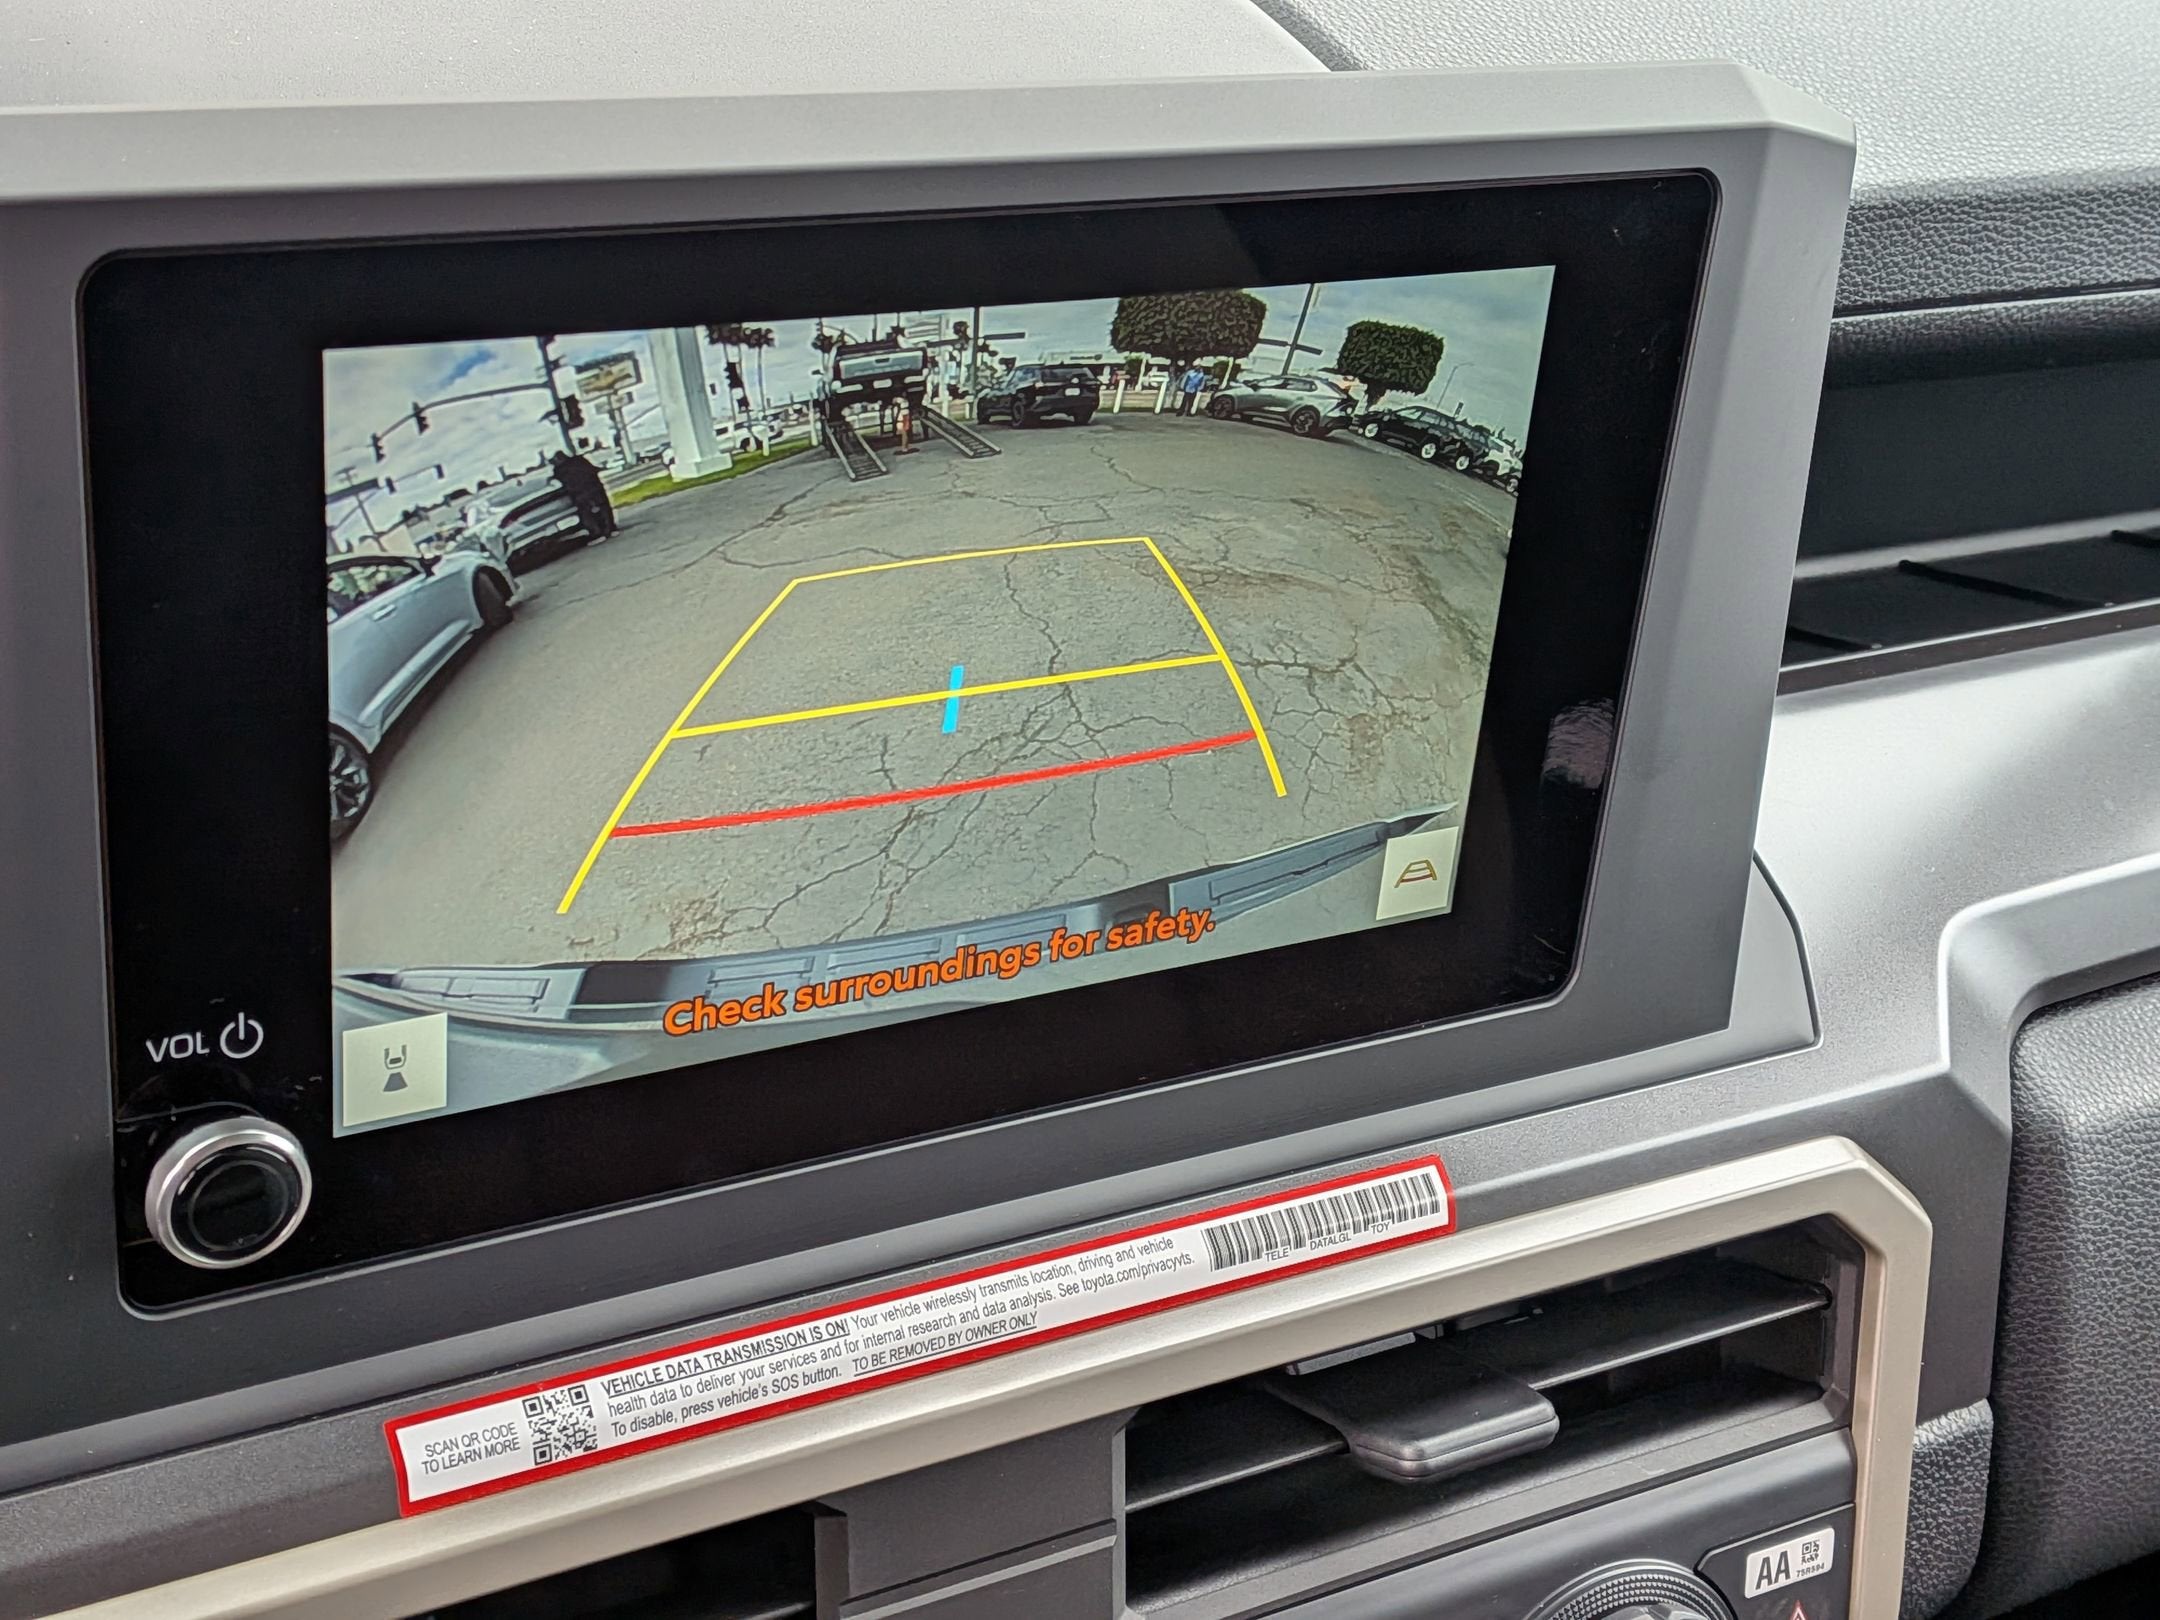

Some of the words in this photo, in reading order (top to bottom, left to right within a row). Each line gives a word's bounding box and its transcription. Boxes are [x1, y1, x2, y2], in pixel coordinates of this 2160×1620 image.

[663, 982, 785, 1037] Check
[793, 935, 1042, 1012] surroundings
[1049, 926, 1100, 963] for
[1105, 905, 1217, 952] safety.
[145, 1031, 210, 1063] VOL
[1265, 1247, 1289, 1262] TELE
[1309, 1234, 1352, 1251] DATALGL
[1371, 1221, 1390, 1235] TOY
[600, 1367, 664, 1396] VEHICLE
[668, 1358, 704, 1380] DATA
[703, 1329, 807, 1365] TRANSMISSION
[811, 1325, 823, 1343] IS
[825, 1318, 850, 1339] ON!
[851, 1315, 878, 1330] Your
[880, 1303, 922, 1323] vehicle
[923, 1286, 977, 1312] wirelessly
[979, 1274, 1029, 1297] transmits
[1030, 1264, 1077, 1284] location,
[1078, 1254, 1114, 1273] driving
[1116, 1247, 1136, 1262] and
[1137, 1237, 1174, 1257] vehicle
[608, 1395, 648, 1418] health
[650, 1389, 678, 1406] data
[680, 1383, 693, 1397] to
[696, 1374, 736, 1394] deliver
[740, 1366, 766, 1388] your
[769, 1352, 817, 1374] services
[820, 1346, 843, 1362] and
[845, 1339, 860, 1354] for
[863, 1325, 905, 1348] internal
[907, 1315, 956, 1338] research
[959, 1306, 981, 1324] and
[982, 1300, 1007, 1318] data
[1008, 1289, 1056, 1312] analysis.
[1057, 1283, 1080, 1298] See
[1083, 1252, 1195, 1294] toyota.com/privacyvts.
[611, 1421, 627, 1438] To
[629, 1410, 678, 1433] disable,
[680, 1402, 715, 1424] press
[717, 1384, 770, 1407] vehicle's
[771, 1377, 800, 1394] SOS
[802, 1365, 843, 1387] button.
[852, 1357, 869, 1373] TO
[871, 1350, 888, 1367] BE
[889, 1336, 946, 1361] REMOVED
[949, 1331, 963, 1347] BY
[965, 1320, 1007, 1341] OWNER
[1008, 1312, 1038, 1331] ONLY
[421, 1458, 440, 1475] TO
[442, 1448, 483, 1470] LEARN
[485, 1437, 520, 1458] MORE
[424, 1438, 459, 1458] SCAN
[461, 1431, 480, 1448] QR
[482, 1422, 518, 1442] CODE
[1755, 1550, 1791, 1591] AA
